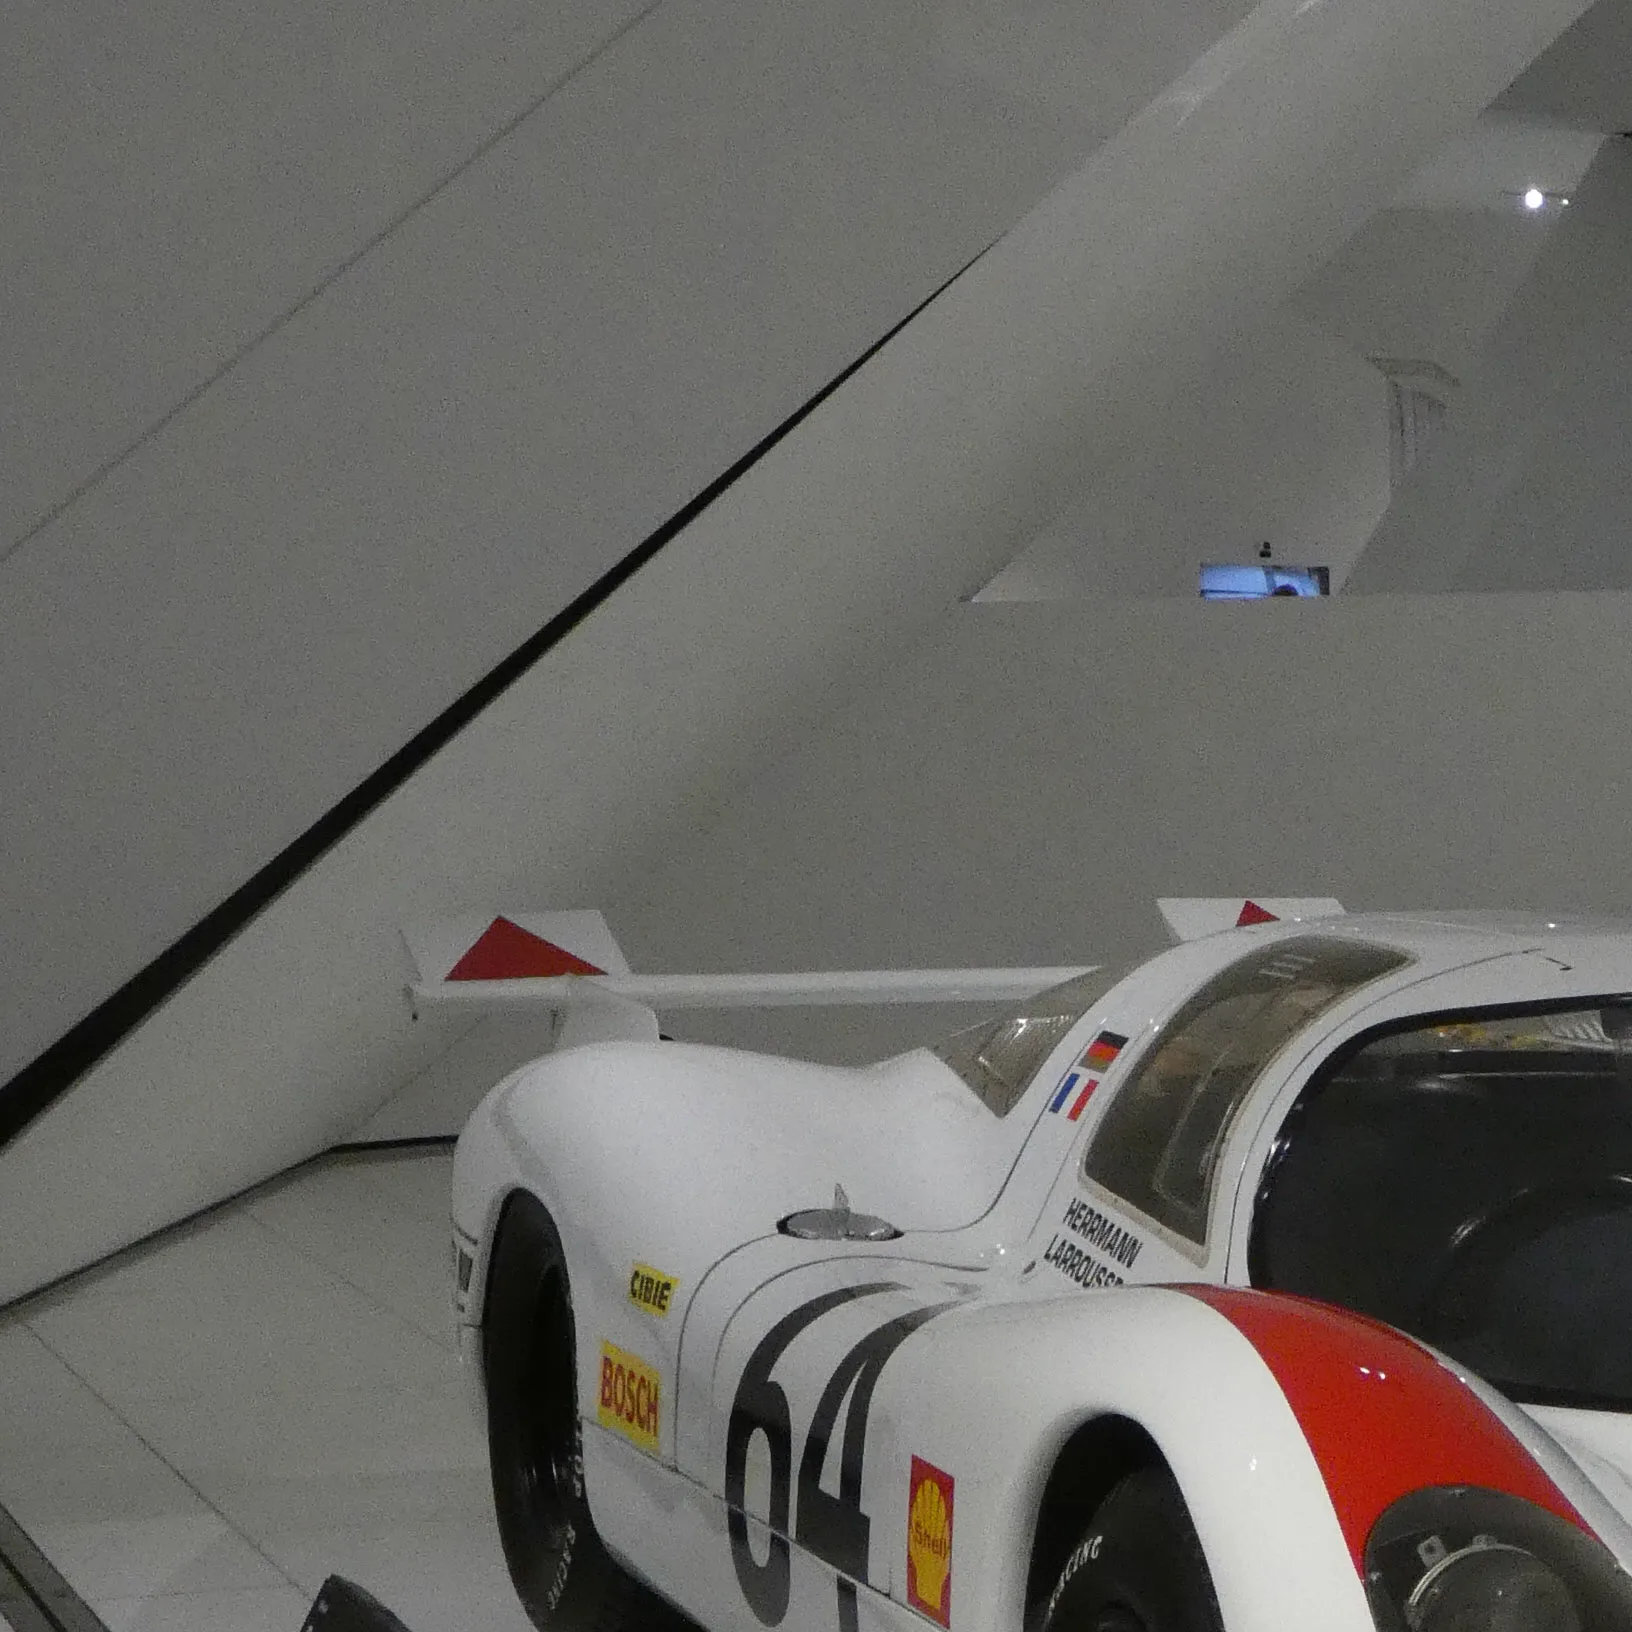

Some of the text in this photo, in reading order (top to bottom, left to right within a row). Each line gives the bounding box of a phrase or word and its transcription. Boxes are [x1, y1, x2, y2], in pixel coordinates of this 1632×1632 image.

[1062, 1197, 1143, 1269] HERRMANN
[601, 1355, 659, 1438] BOSCH
[913, 1522, 948, 1560] Shell
